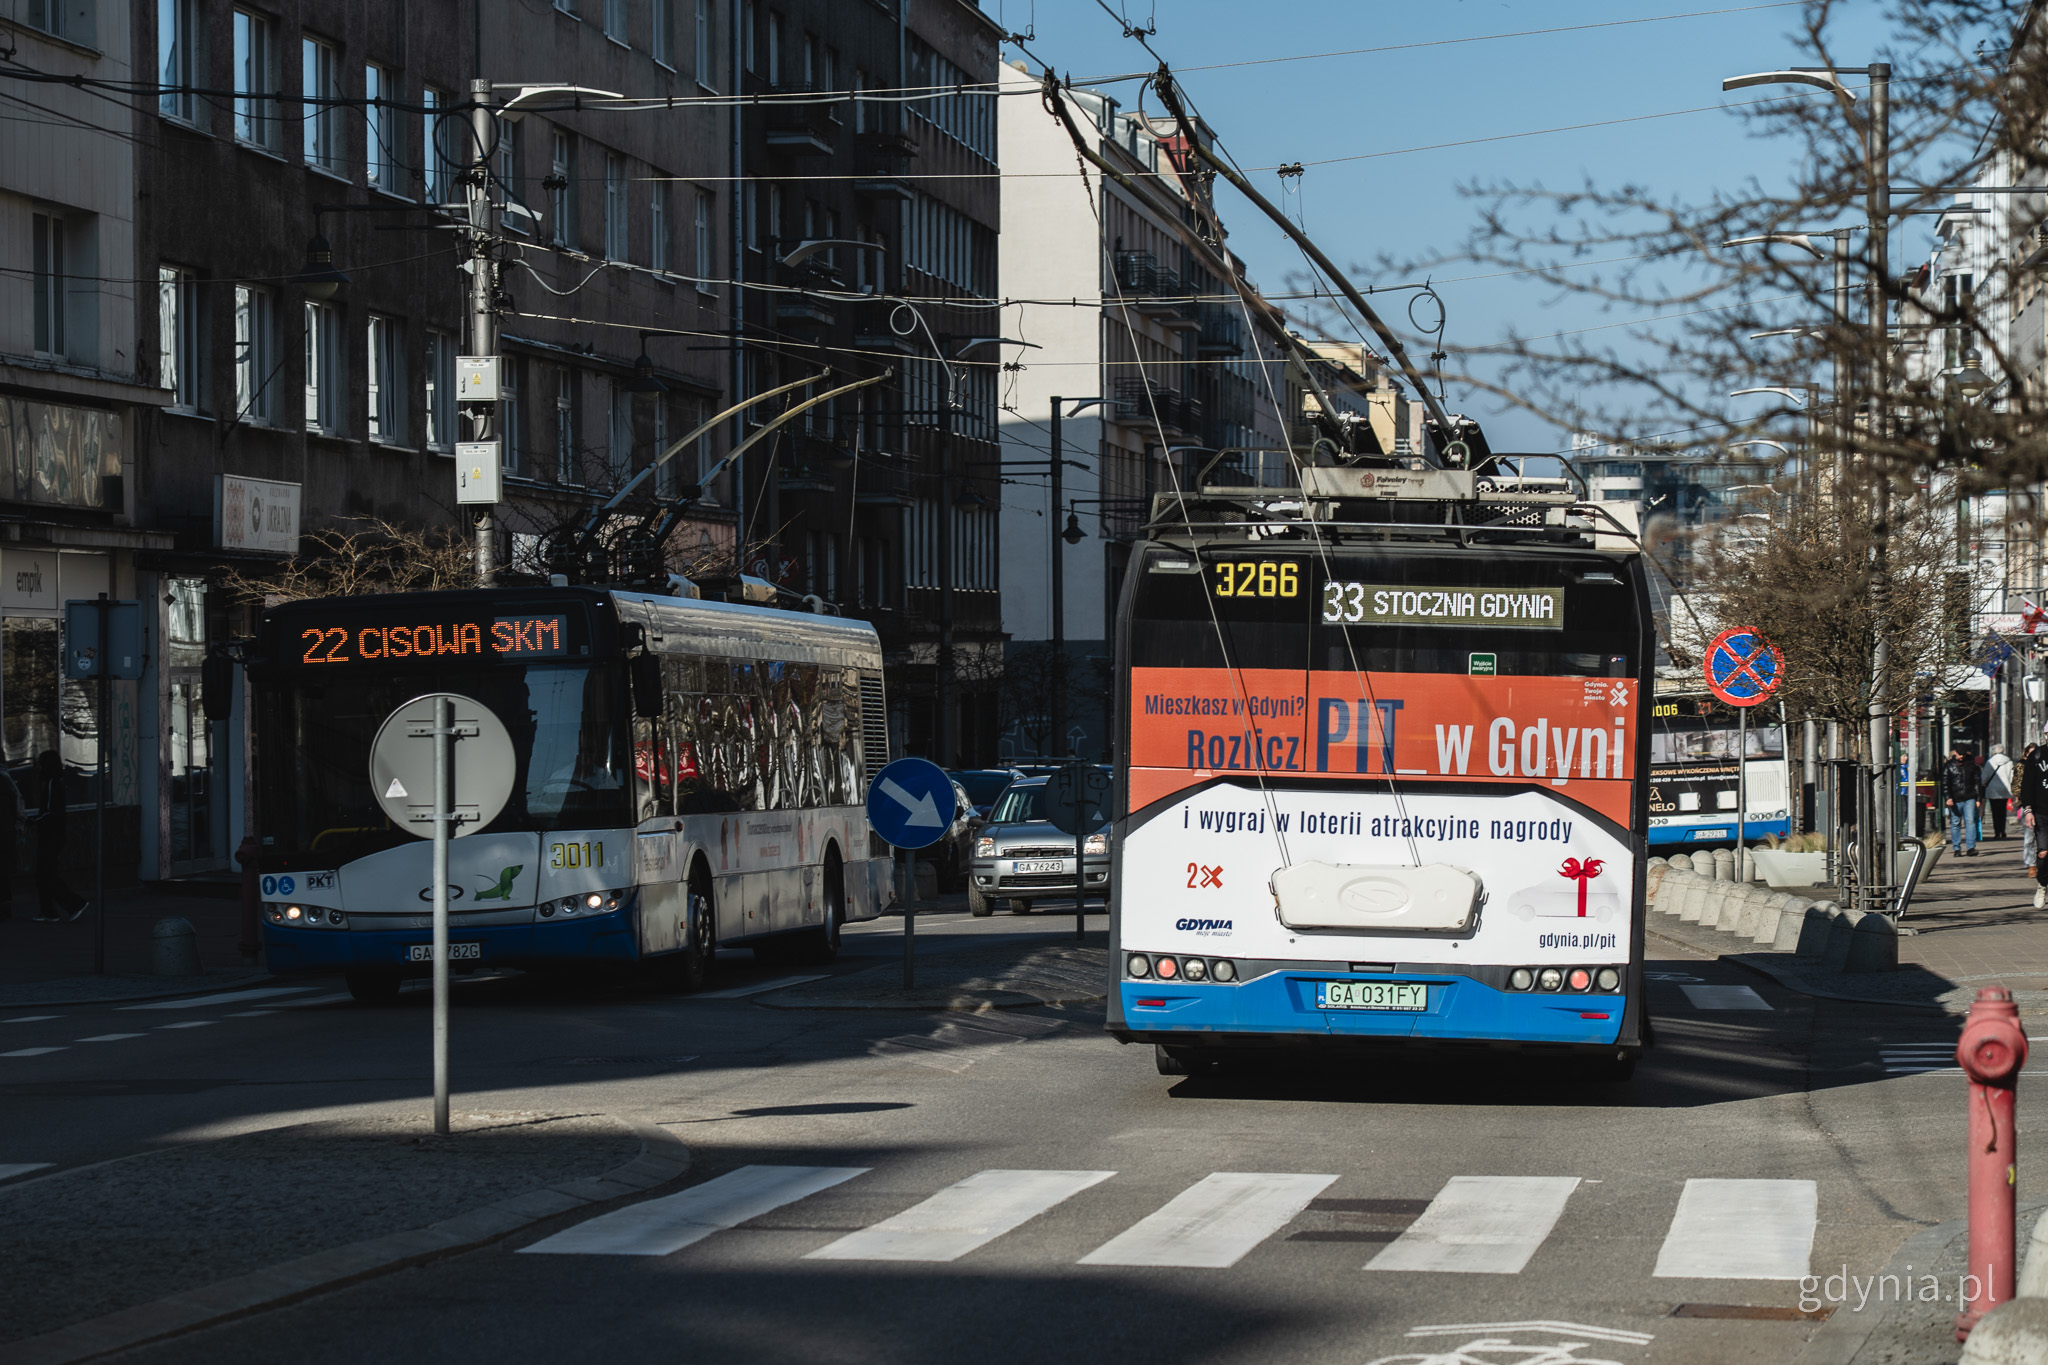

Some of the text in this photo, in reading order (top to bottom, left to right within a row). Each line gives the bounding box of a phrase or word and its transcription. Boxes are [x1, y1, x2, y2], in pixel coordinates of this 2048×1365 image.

[16, 561, 42, 598] empik
[1215, 562, 1298, 597] 3266
[1324, 581, 1554, 622] 33 STOCZNIA GDYNIA
[302, 618, 560, 664] 22 CISOWA SKM
[1584, 681, 1609, 689] Gdynia.
[1145, 694, 1305, 719] Mieszkasz w Gdyni?
[1187, 728, 1300, 770] Rozlicz
[1435, 724, 1474, 775] w
[1489, 717, 1625, 786] Gdyni
[1183, 805, 1573, 844] i wygraj w loterii atrakcyjne nagrody
[550, 842, 604, 870] 3011
[1019, 862, 1060, 873] GA 76243
[307, 875, 334, 890] PKT
[1176, 918, 1233, 931] GDYNIA
[412, 946, 432, 960] GA
[1538, 931, 1616, 950] gdynia.pl/pit
[1330, 985, 1422, 1005] GA 031FY
